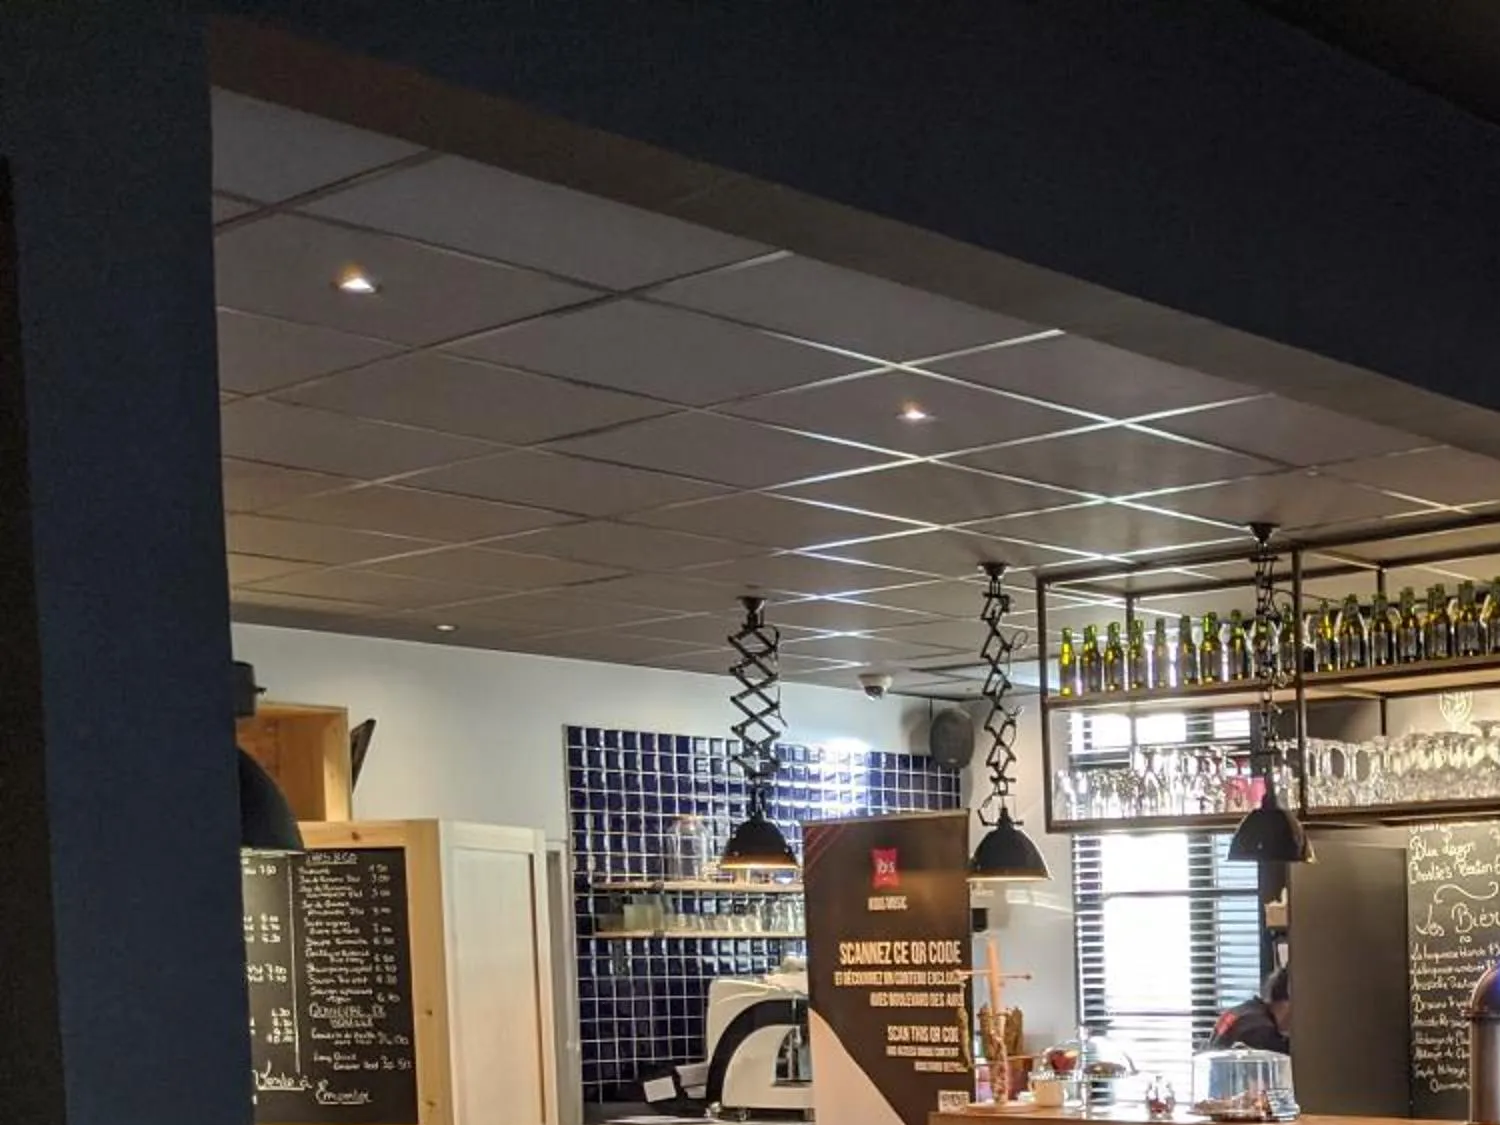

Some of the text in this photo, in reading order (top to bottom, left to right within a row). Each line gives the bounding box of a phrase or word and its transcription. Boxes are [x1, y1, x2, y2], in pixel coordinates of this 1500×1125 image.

[840, 940, 962, 965] SCANNEZ CE QR CODE
